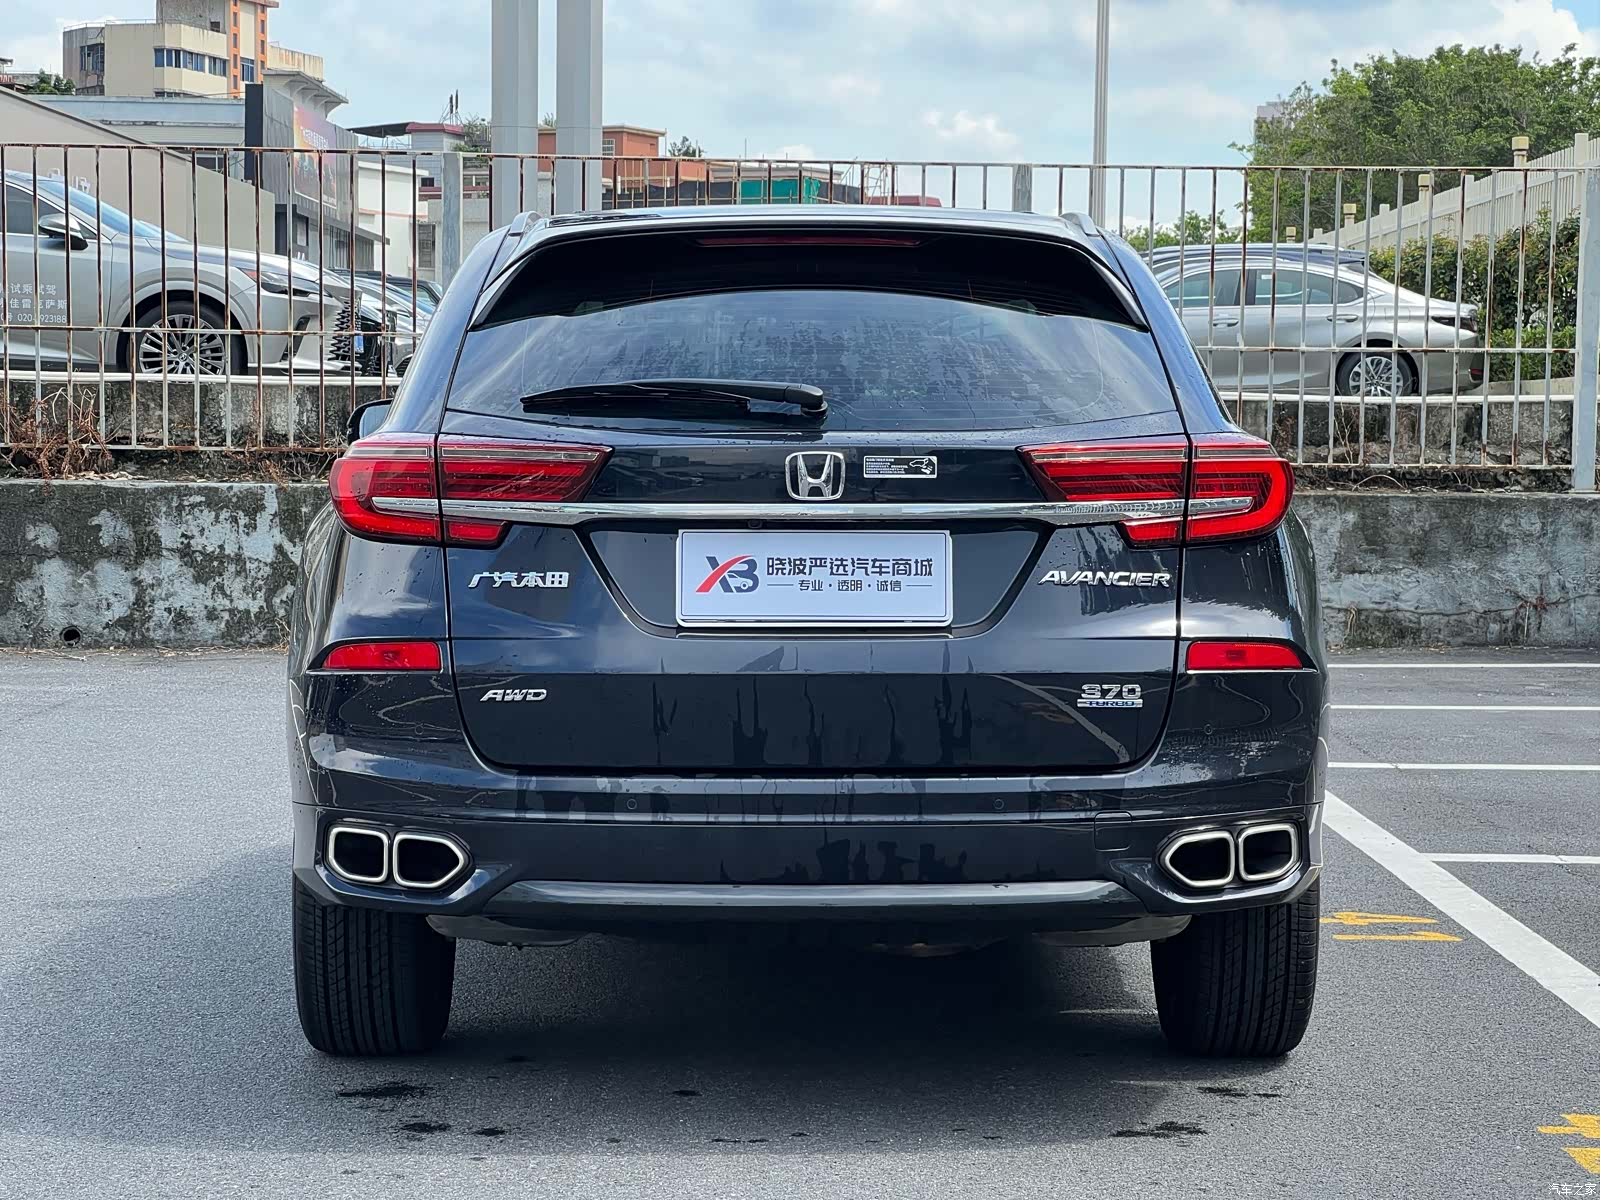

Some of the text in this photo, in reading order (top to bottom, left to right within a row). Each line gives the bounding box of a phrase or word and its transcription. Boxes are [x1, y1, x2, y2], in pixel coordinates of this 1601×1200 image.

[766, 556, 934, 577] 晓波严选汽车商城
[468, 571, 570, 588] 广汽本田
[1037, 570, 1171, 588] AVANCIER
[479, 688, 548, 702] AWD
[1080, 684, 1142, 699] 370
